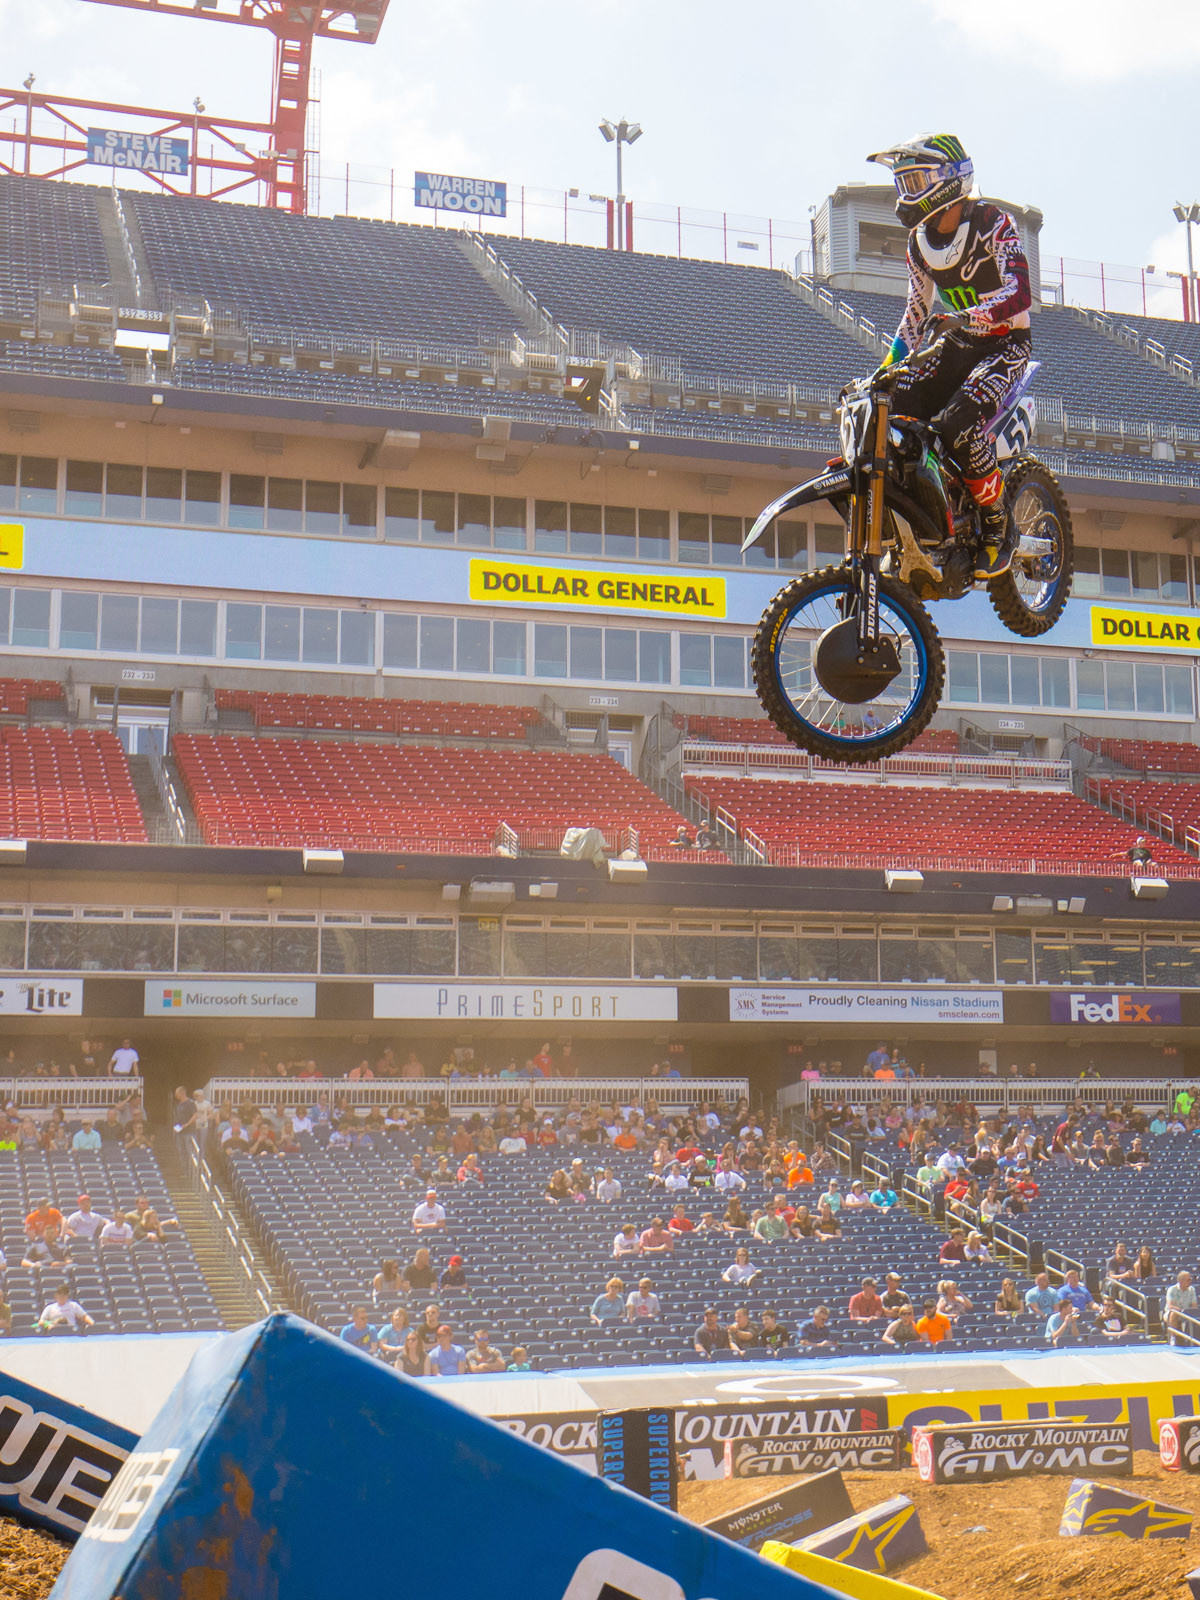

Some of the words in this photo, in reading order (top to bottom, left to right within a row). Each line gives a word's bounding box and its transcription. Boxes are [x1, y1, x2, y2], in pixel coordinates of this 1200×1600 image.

[105, 131, 172, 154] STEVE
[94, 146, 181, 173] McNAIR
[427, 174, 496, 197] WARREN
[420, 189, 501, 215] MOON
[821, 473, 849, 488] YAMAHA
[482, 571, 589, 598] DOLLAR
[597, 580, 715, 607] GENERAL
[867, 573, 877, 640] DUNLOP
[1101, 617, 1190, 641] DOLLAR
[25, 985, 72, 1013] Lite
[186, 992, 248, 1007] Microsoft
[251, 993, 299, 1007] Surface
[737, 1000, 755, 1010] SMS
[808, 995, 852, 1009] Proudly
[856, 995, 908, 1009] Cleaning
[910, 997, 950, 1008] Nissan
[952, 997, 1000, 1009] Stadium
[1070, 994, 1153, 1023] FedEx
[937, 1010, 1001, 1020] smsclean.com
[760, 1438, 812, 1455] ROCKY
[813, 1433, 895, 1451] MOUNTAIN
[968, 1432, 1029, 1450] ROCKY
[1032, 1427, 1130, 1446] MOUNTAIN
[728, 1502, 784, 1532] MONSTER
